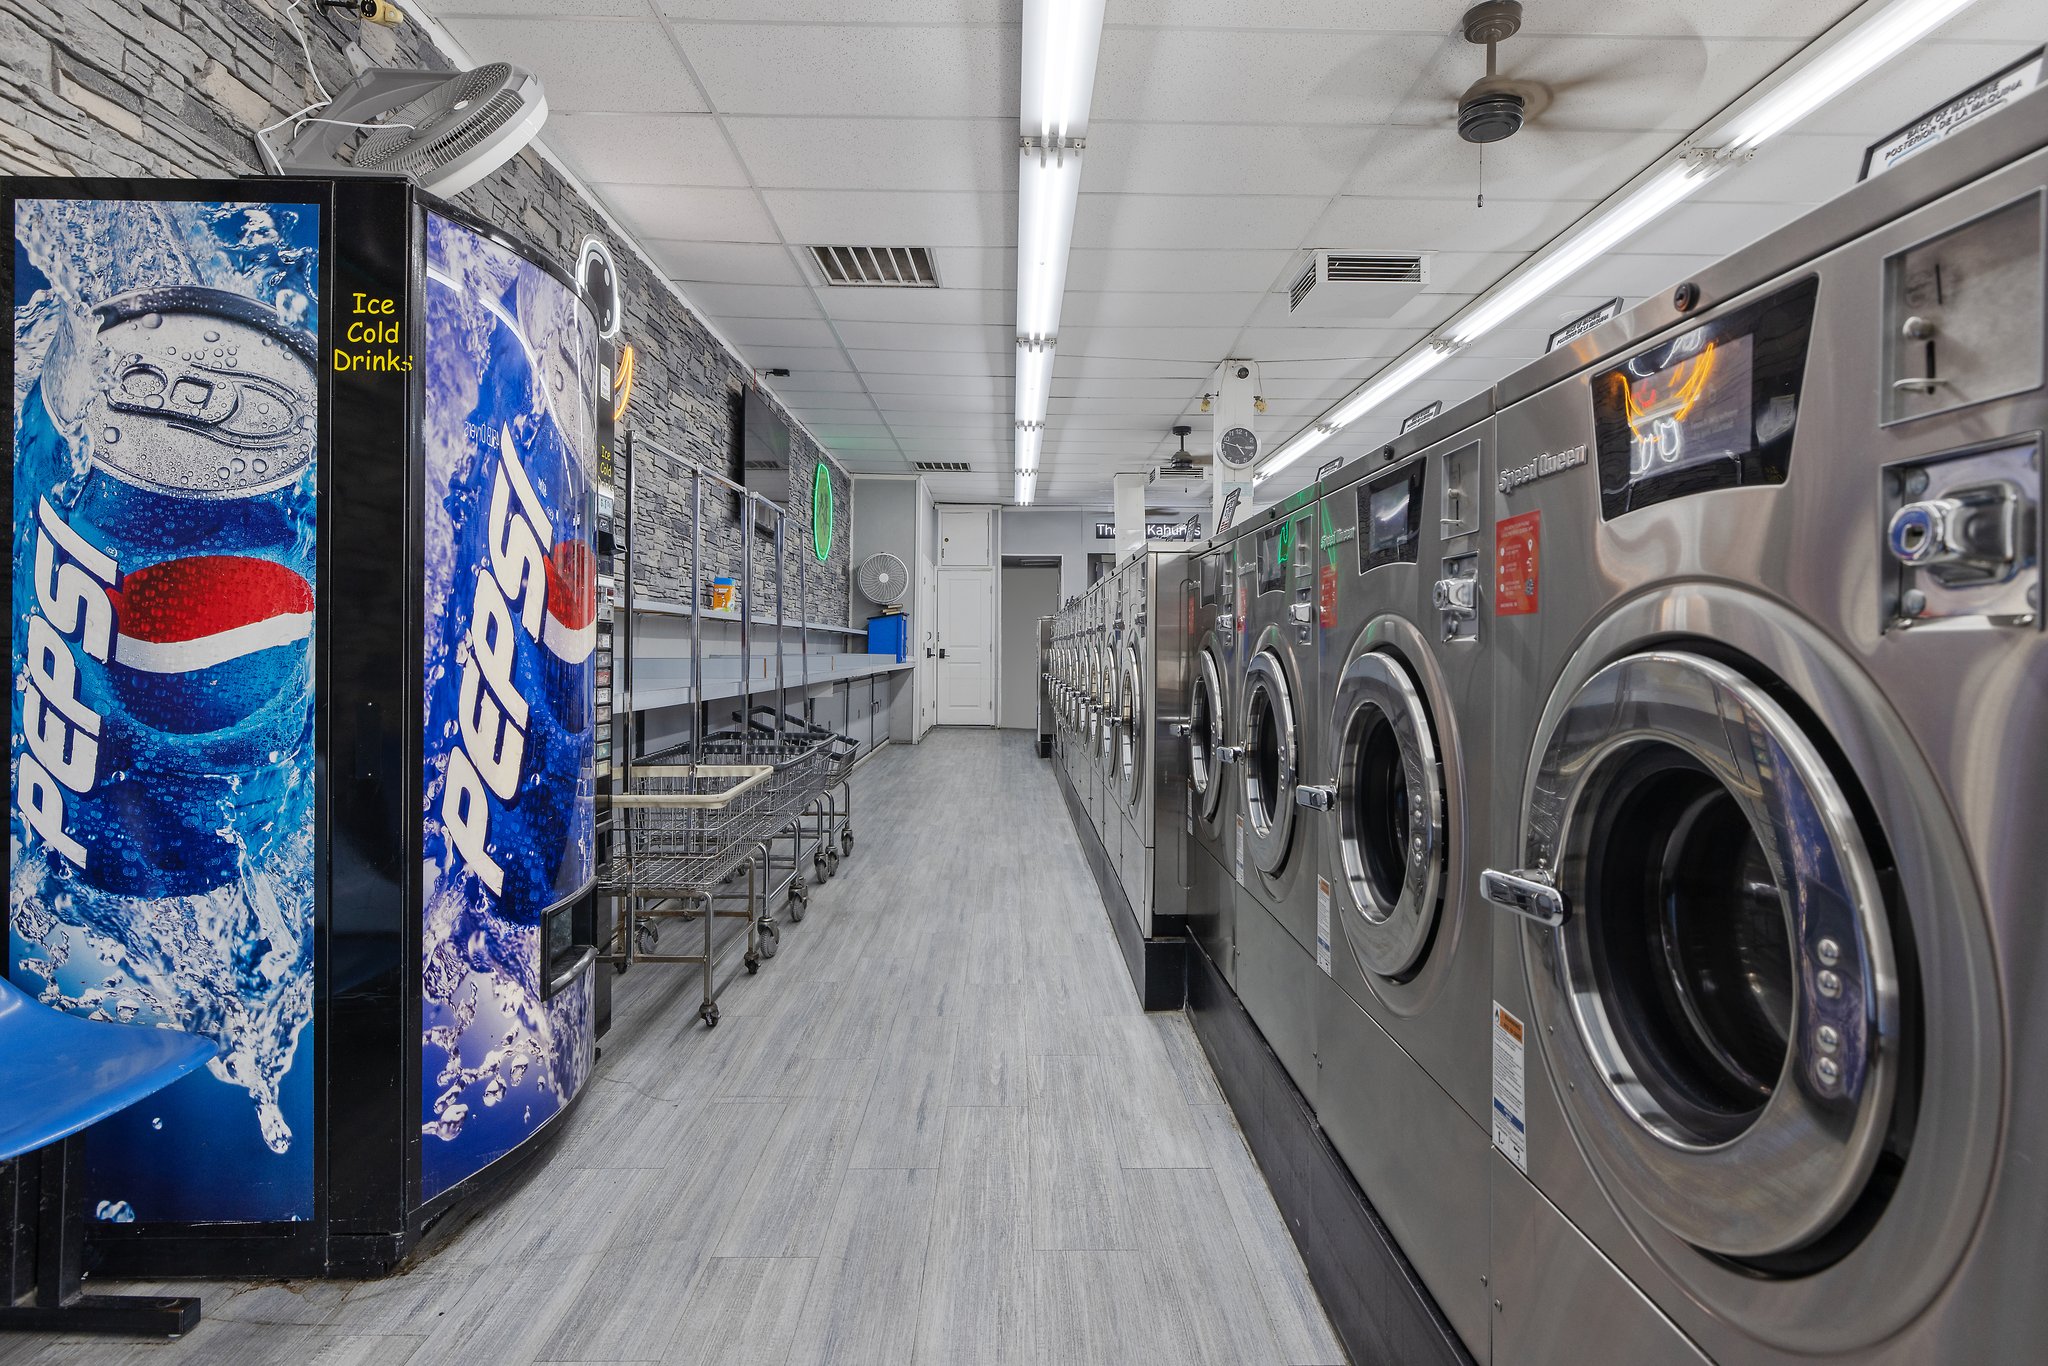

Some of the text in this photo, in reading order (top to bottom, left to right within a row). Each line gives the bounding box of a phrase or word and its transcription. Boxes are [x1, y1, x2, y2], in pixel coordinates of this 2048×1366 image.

[1885, 80, 2022, 160] POSTERIOR DE LA MAQUINA
[1907, 81, 2000, 140] BACK OF MACHINE
[353, 292, 395, 315] Ice
[347, 320, 399, 344] Cold
[334, 348, 413, 372] Drinks
[601, 445, 611, 461] Ice
[600, 461, 612, 478] Cold
[1498, 444, 1587, 494] Speed Queen
[1147, 524, 1201, 537] Kahuns
[442, 420, 553, 897] PEPSI
[18, 494, 119, 870] PEPSI
